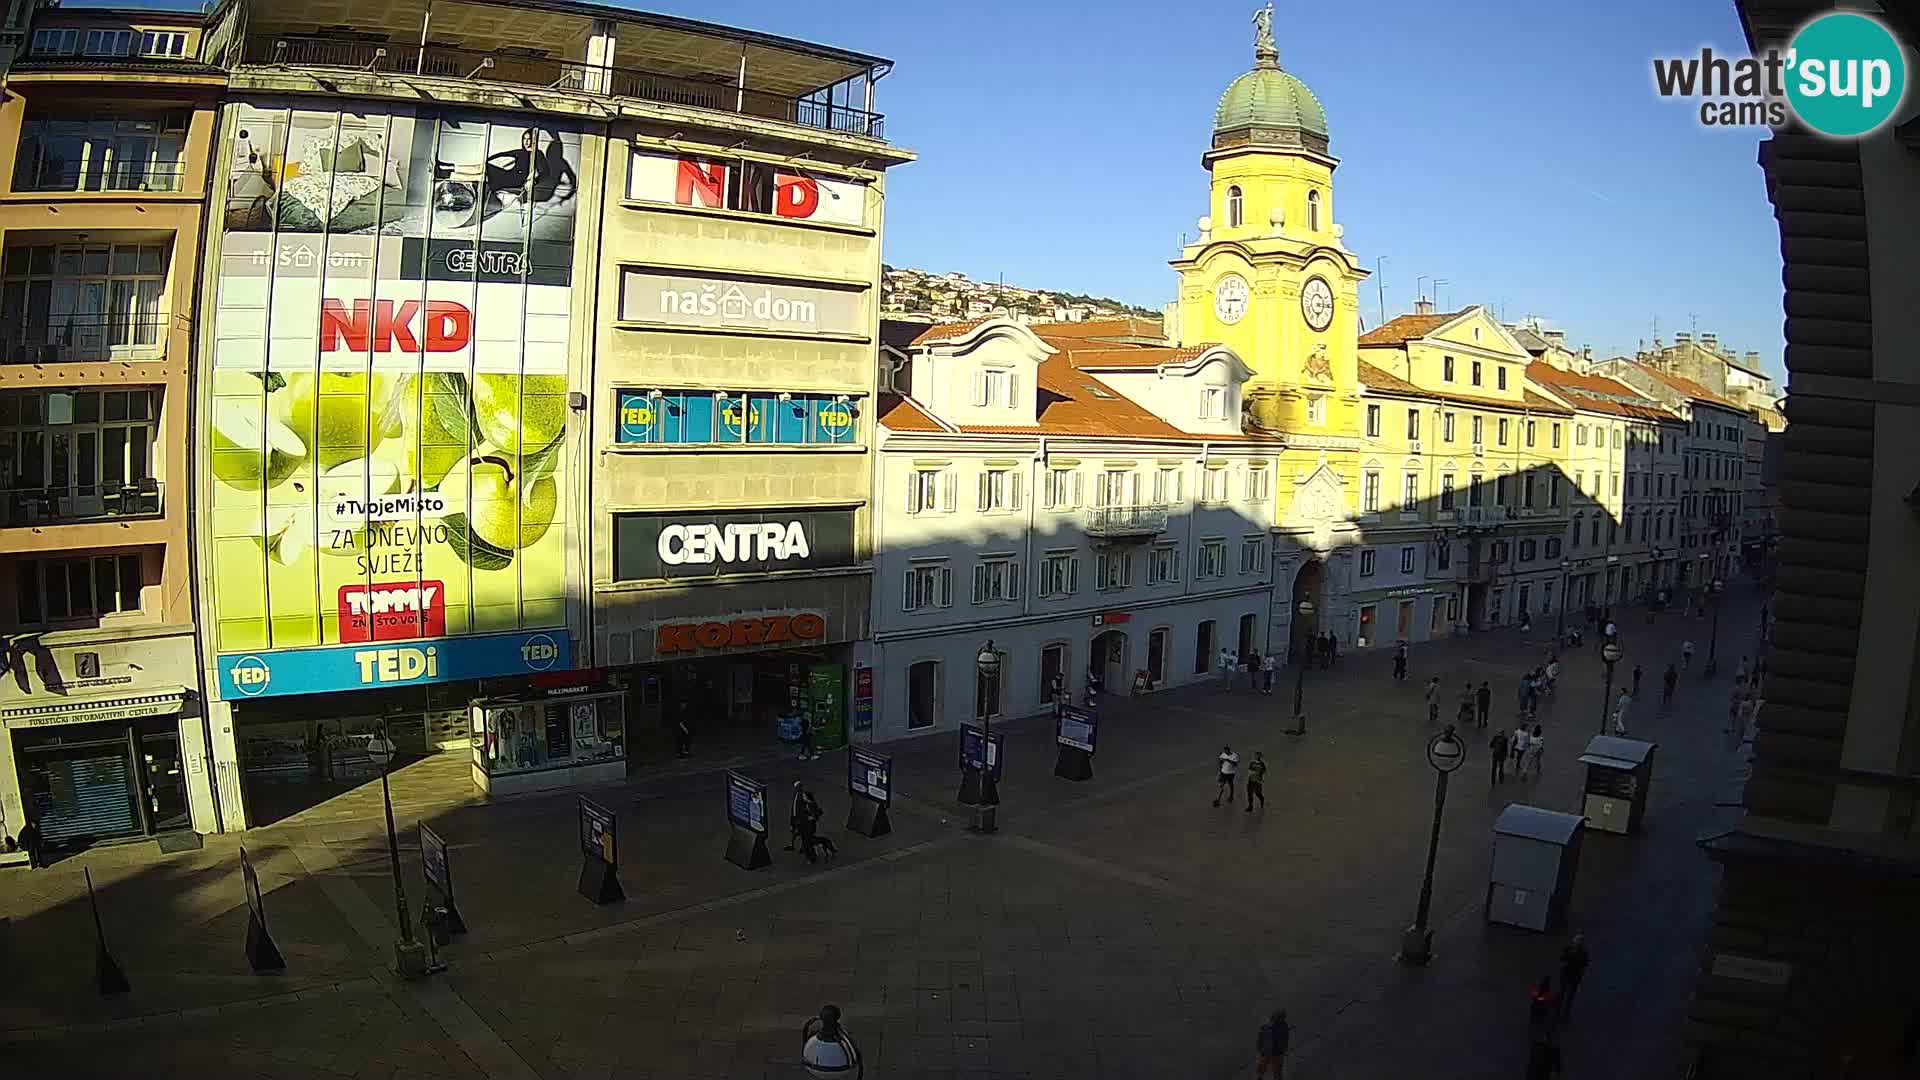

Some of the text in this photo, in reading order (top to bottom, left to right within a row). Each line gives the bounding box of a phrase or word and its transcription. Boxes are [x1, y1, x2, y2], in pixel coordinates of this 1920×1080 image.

[675, 157, 819, 218] NKD
[446, 249, 533, 275] CENTRA
[659, 284, 815, 323] naš dom
[320, 297, 472, 353] NKD
[336, 496, 444, 517] #TvojeMisto
[331, 524, 448, 549] ZA DNEVNO
[658, 520, 810, 565] CENTRA
[357, 550, 424, 576] SVJEŽE
[346, 586, 437, 615] TOMMY
[352, 618, 368, 628] ZN
[656, 613, 825, 653] KORZO
[355, 646, 437, 684] TEDi
[521, 644, 558, 661] TEDi
[230, 665, 270, 686] TEDi
